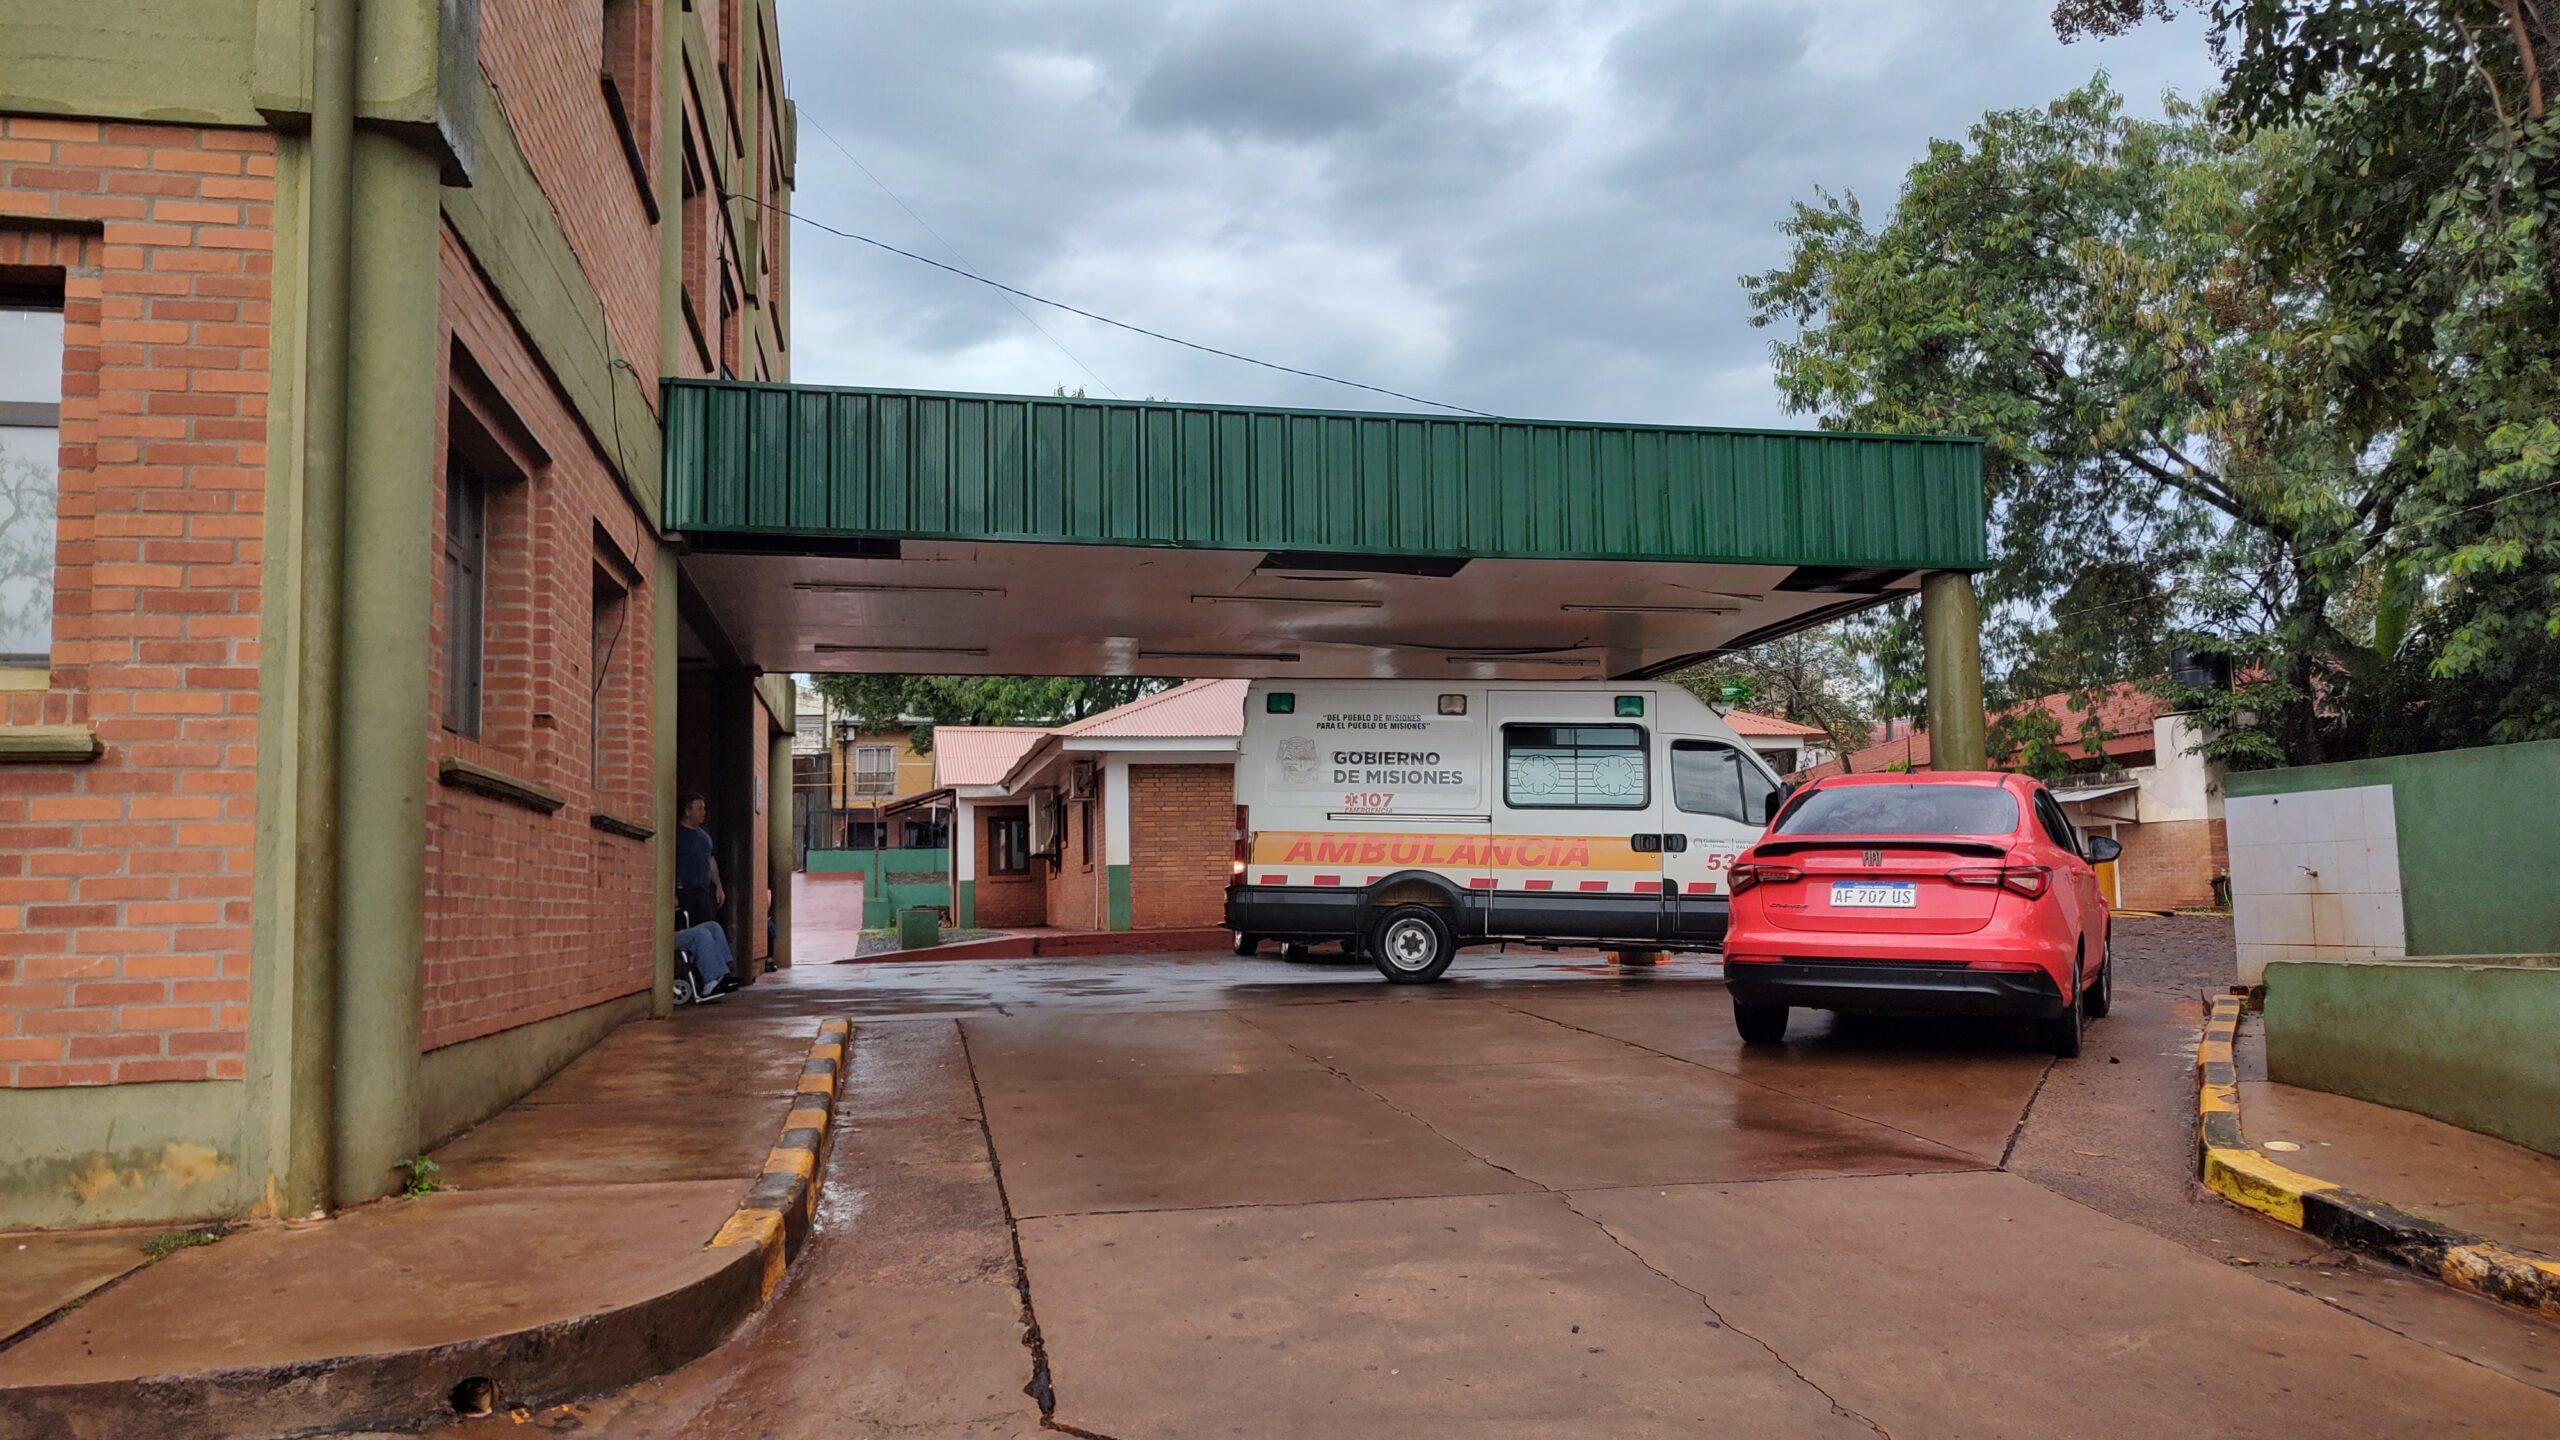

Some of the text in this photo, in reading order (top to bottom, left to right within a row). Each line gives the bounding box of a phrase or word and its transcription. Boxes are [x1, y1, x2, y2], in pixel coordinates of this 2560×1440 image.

[1385, 714, 1421, 722] MISIONES
[1334, 751, 1440, 765] GOBIERNO
[1333, 770, 1463, 784] DE MISIONES
[1360, 793, 1395, 807] 107
[1284, 834, 1589, 867] AMBULANCIA
[1862, 849, 1883, 867] FIAT
[1834, 890, 1911, 903] AF 707 US
